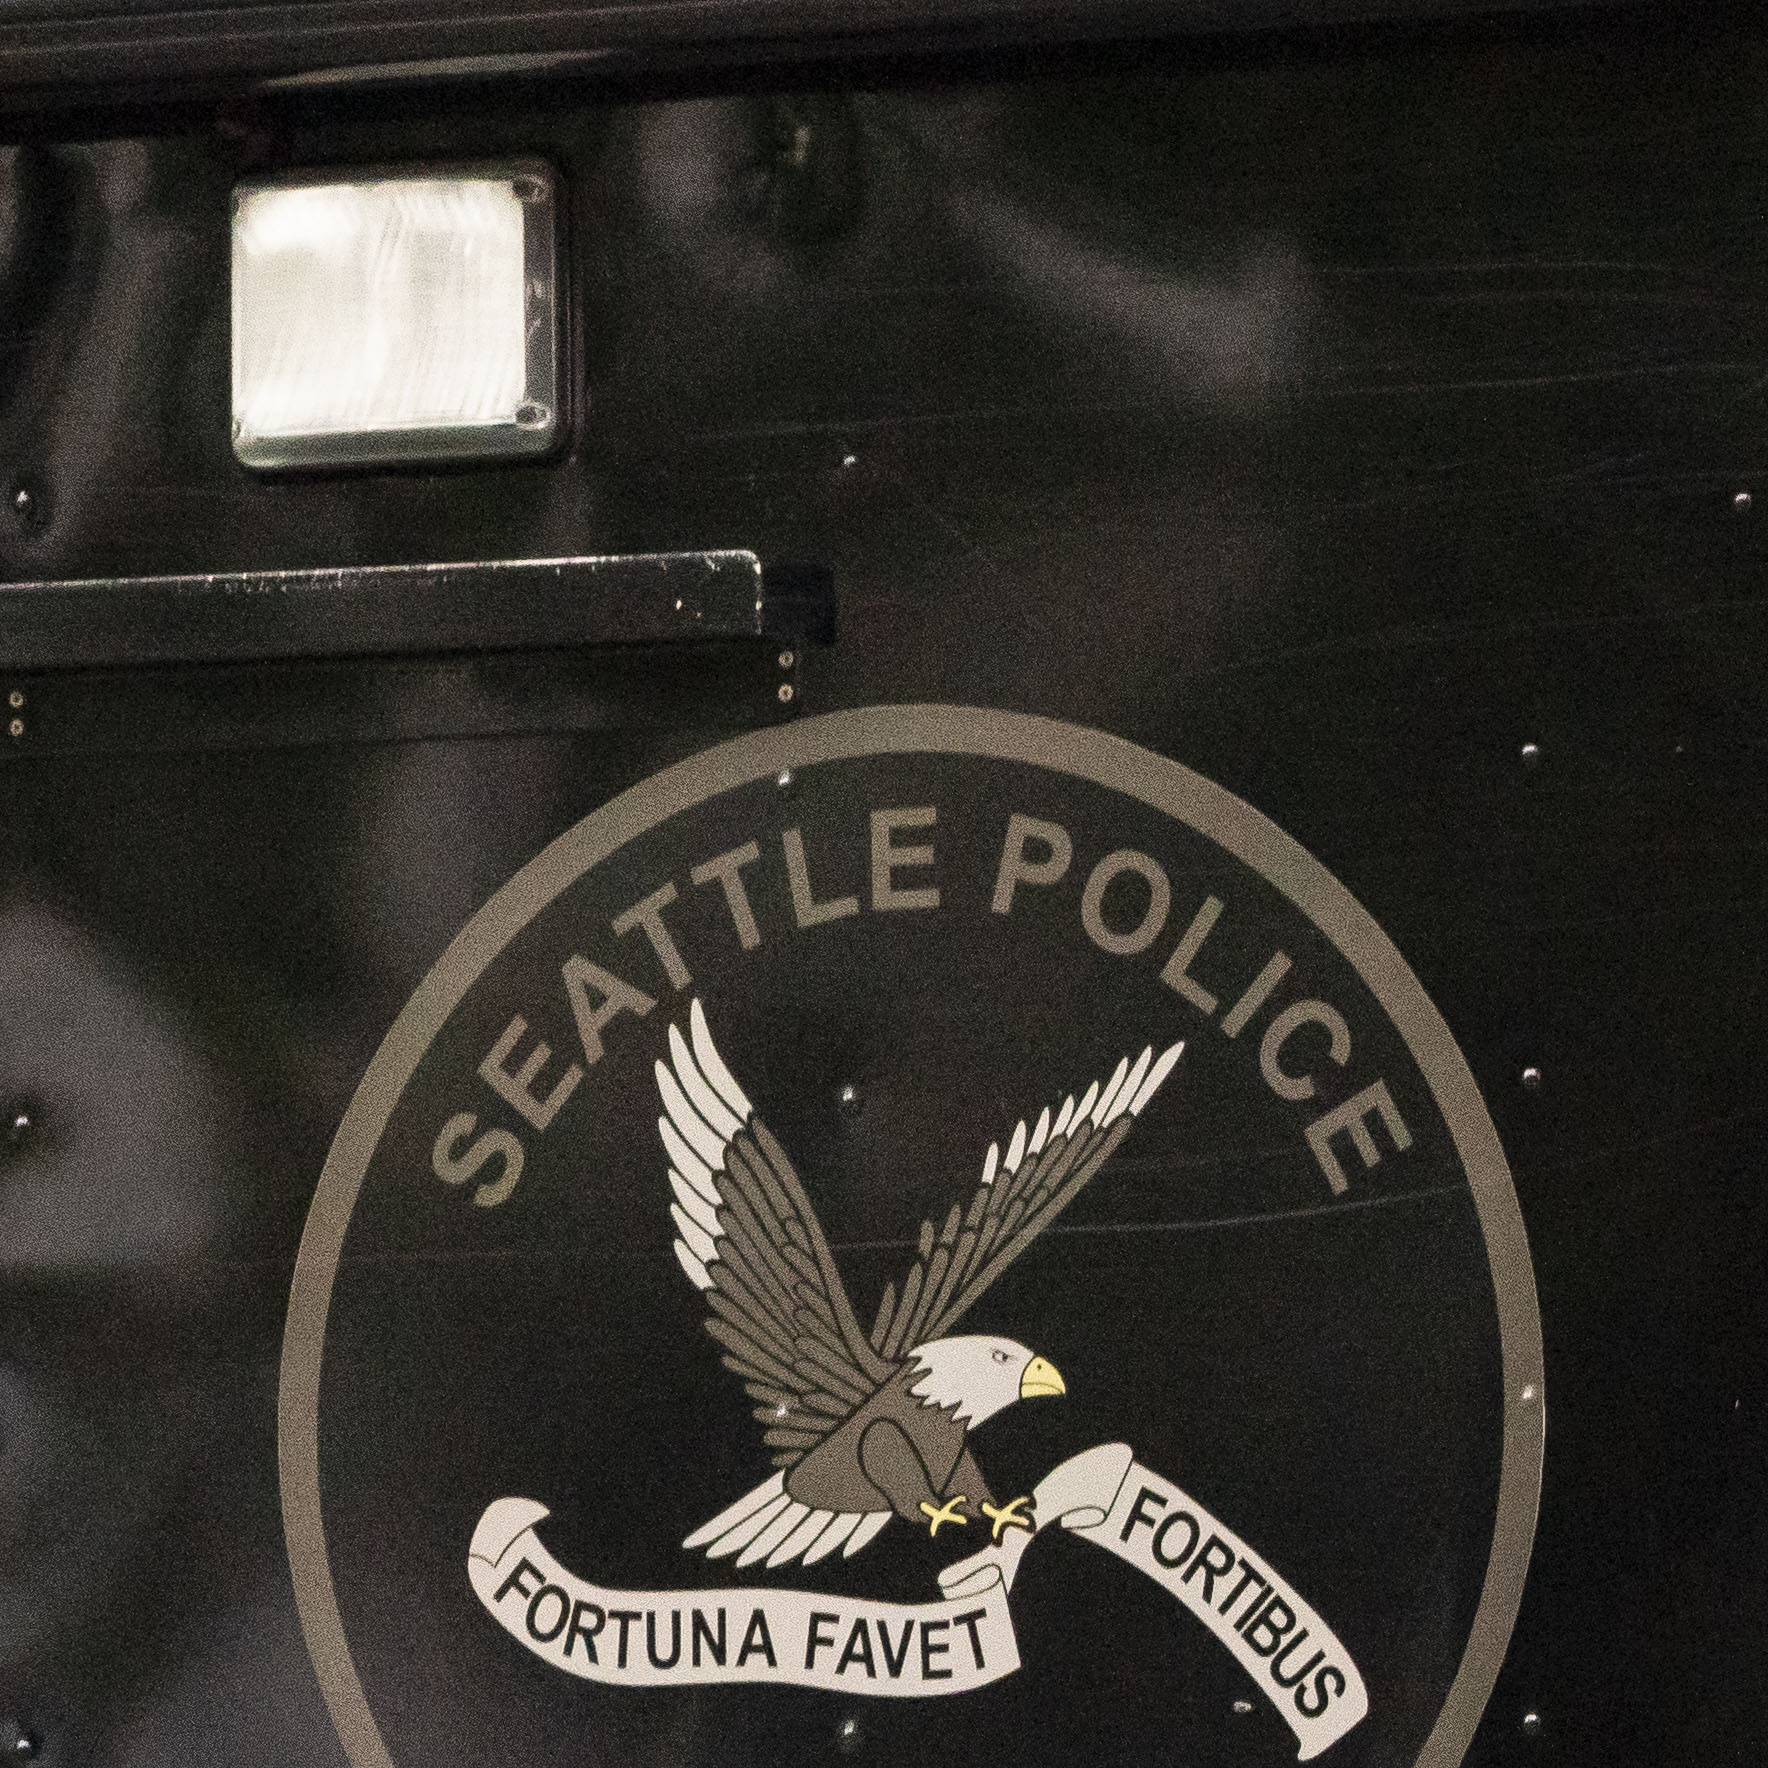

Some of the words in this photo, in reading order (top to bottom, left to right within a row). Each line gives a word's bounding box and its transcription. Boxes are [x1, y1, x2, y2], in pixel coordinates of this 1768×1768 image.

[429, 804, 942, 1209] SEATTLE
[989, 812, 1413, 1196] POLICE
[494, 1560, 778, 1670] FORTUNA
[804, 1608, 988, 1680] FAVET
[1120, 1487, 1347, 1720] FORTIBUS
